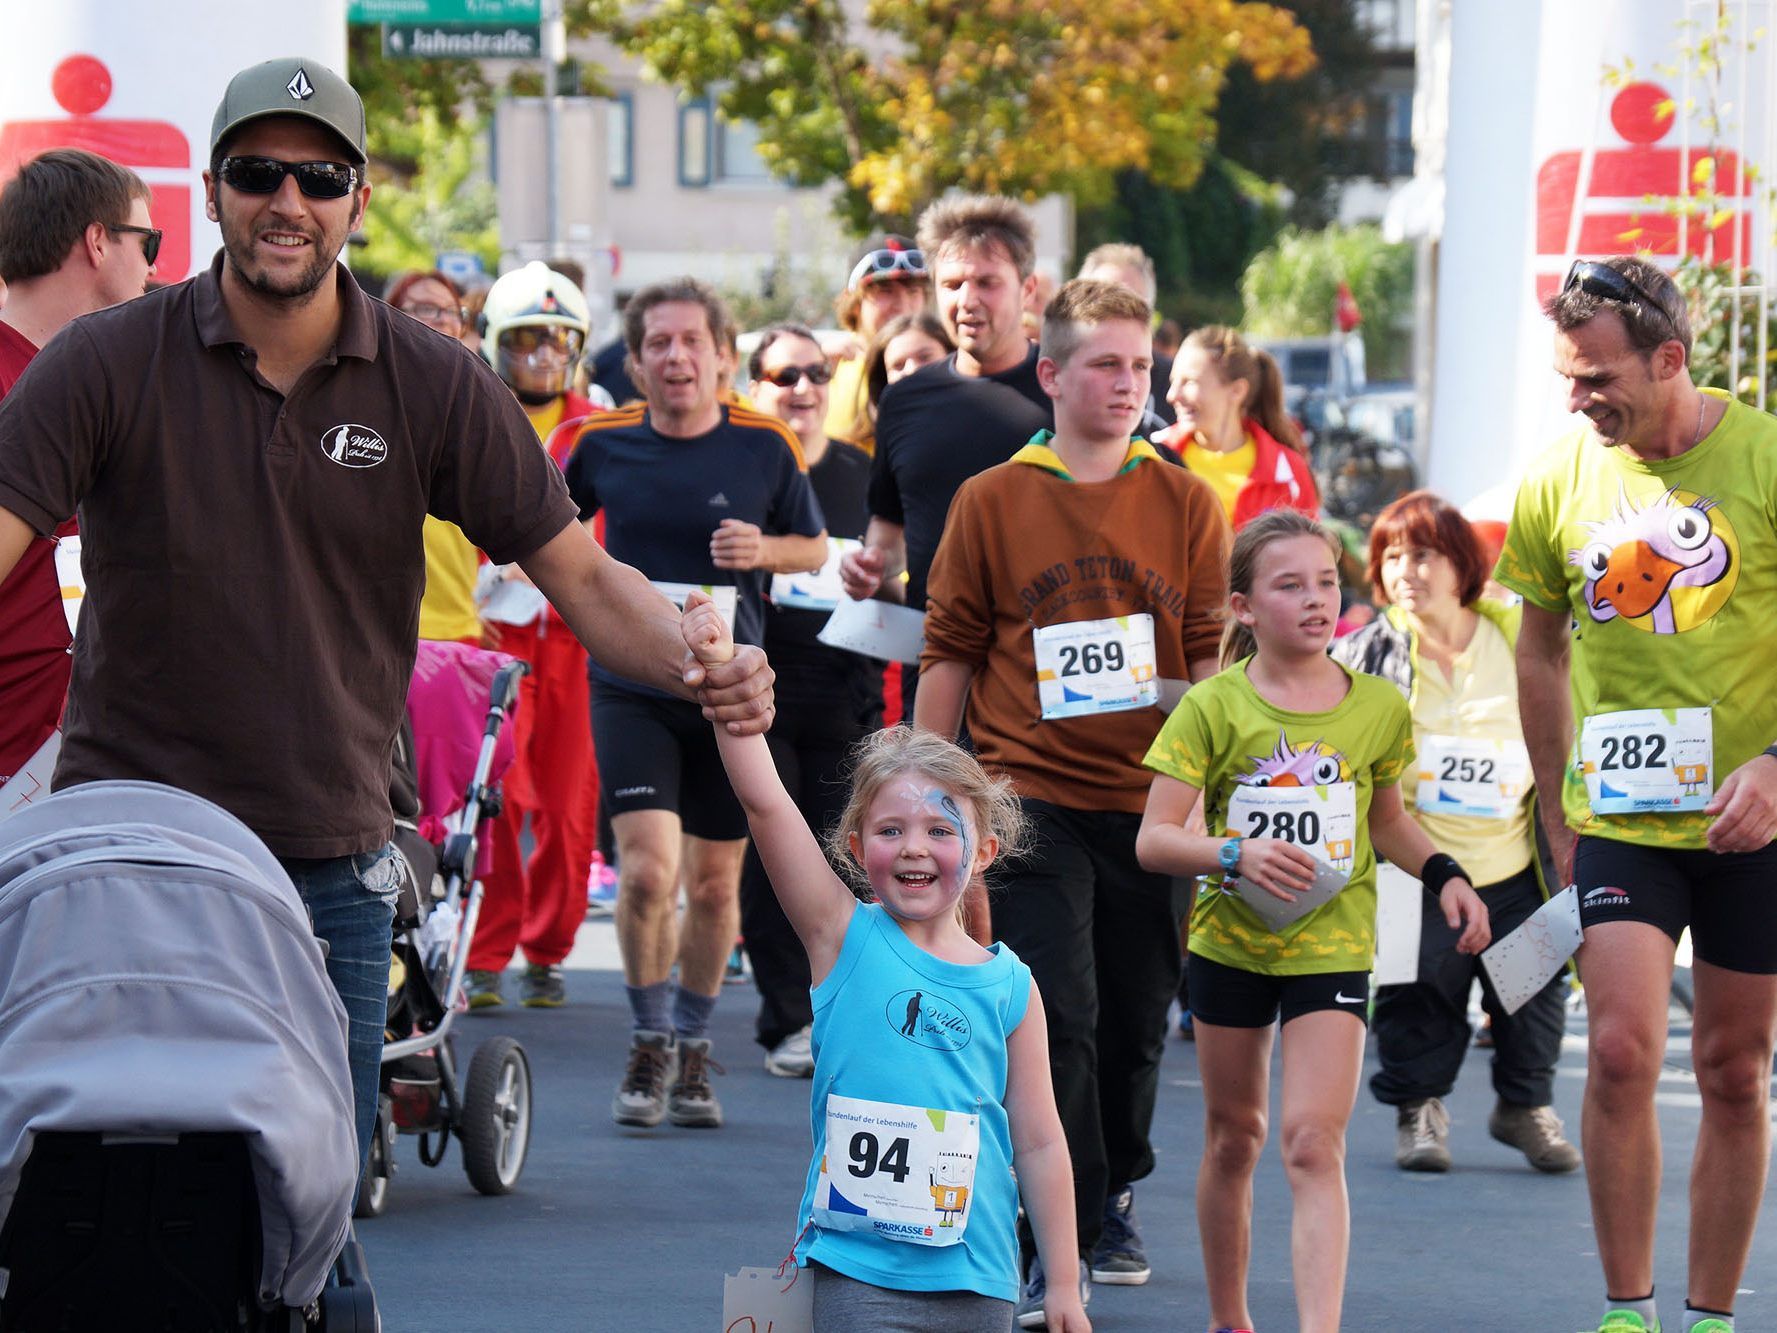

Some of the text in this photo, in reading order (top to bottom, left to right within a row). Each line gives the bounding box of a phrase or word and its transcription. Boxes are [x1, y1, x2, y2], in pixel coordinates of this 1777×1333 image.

[410, 28, 535, 54] Jahnstraße
[350, 434, 384, 451] Willis
[1075, 555, 1136, 582] TETON
[1059, 640, 1124, 678] 269
[1600, 733, 1668, 771] 282
[1441, 756, 1495, 784] 252
[1247, 810, 1320, 846] 280
[1583, 896, 1631, 908] skinfit
[926, 1006, 967, 1034] Willis
[862, 1116, 875, 1124] der
[876, 1117, 918, 1130] Lebenshilfe
[847, 1131, 911, 1184] 94
[873, 1220, 924, 1236] SPARKASSE
